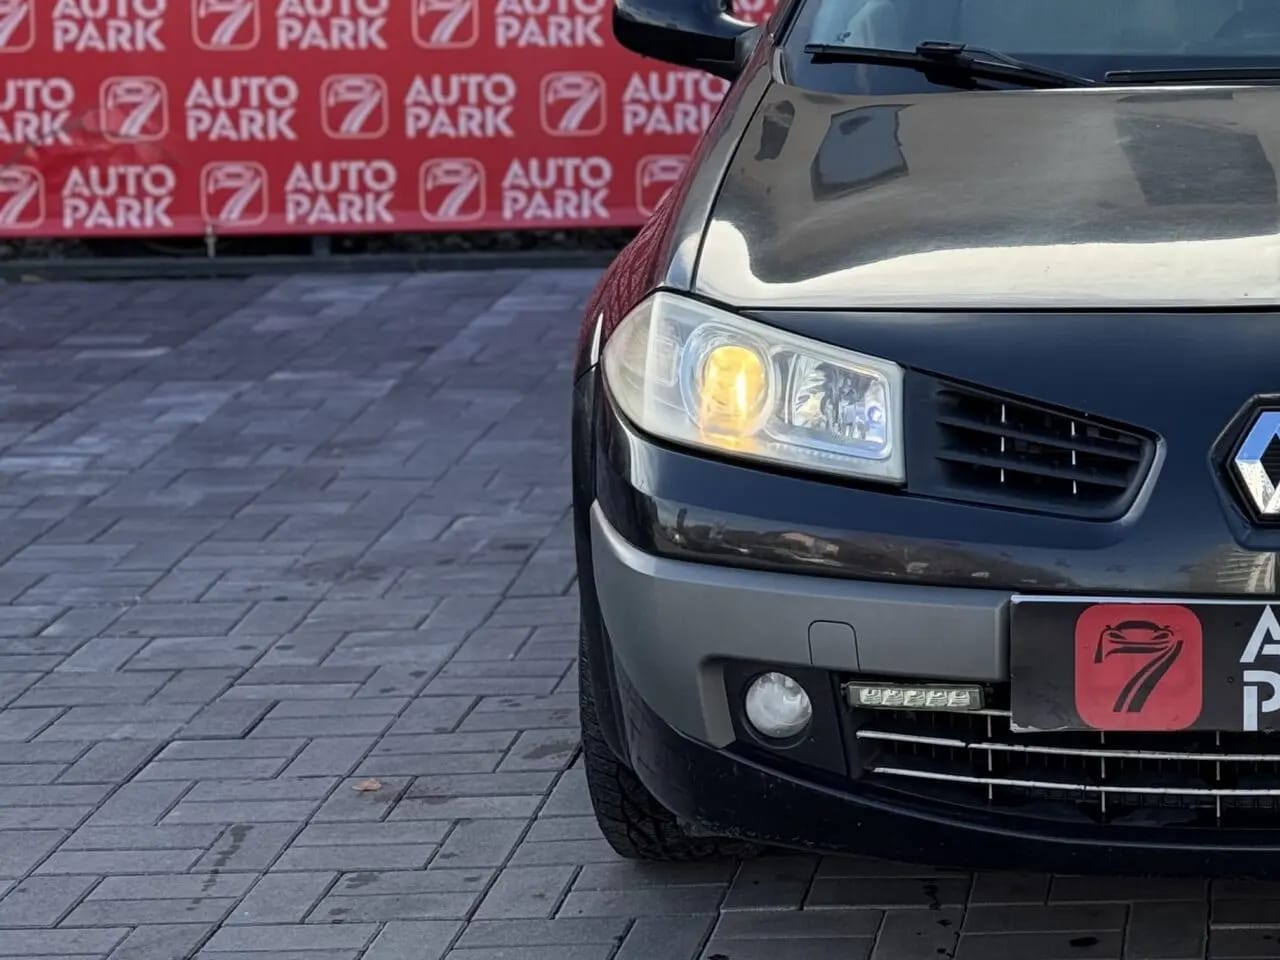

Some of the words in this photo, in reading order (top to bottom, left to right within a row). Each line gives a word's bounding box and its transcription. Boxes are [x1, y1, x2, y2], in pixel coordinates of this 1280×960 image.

[53, 19, 164, 51] PARK
[278, 17, 386, 49] PARK
[185, 76, 298, 107] AUTO
[405, 74, 516, 105] AUTO
[187, 108, 296, 139] PARK
[406, 106, 513, 136] PARK
[63, 165, 175, 196] AUTO
[286, 160, 396, 192] AUTO
[503, 157, 611, 188] AUTO
[63, 197, 174, 230] PARK
[286, 193, 395, 225] PARK
[502, 189, 609, 221] PARK
